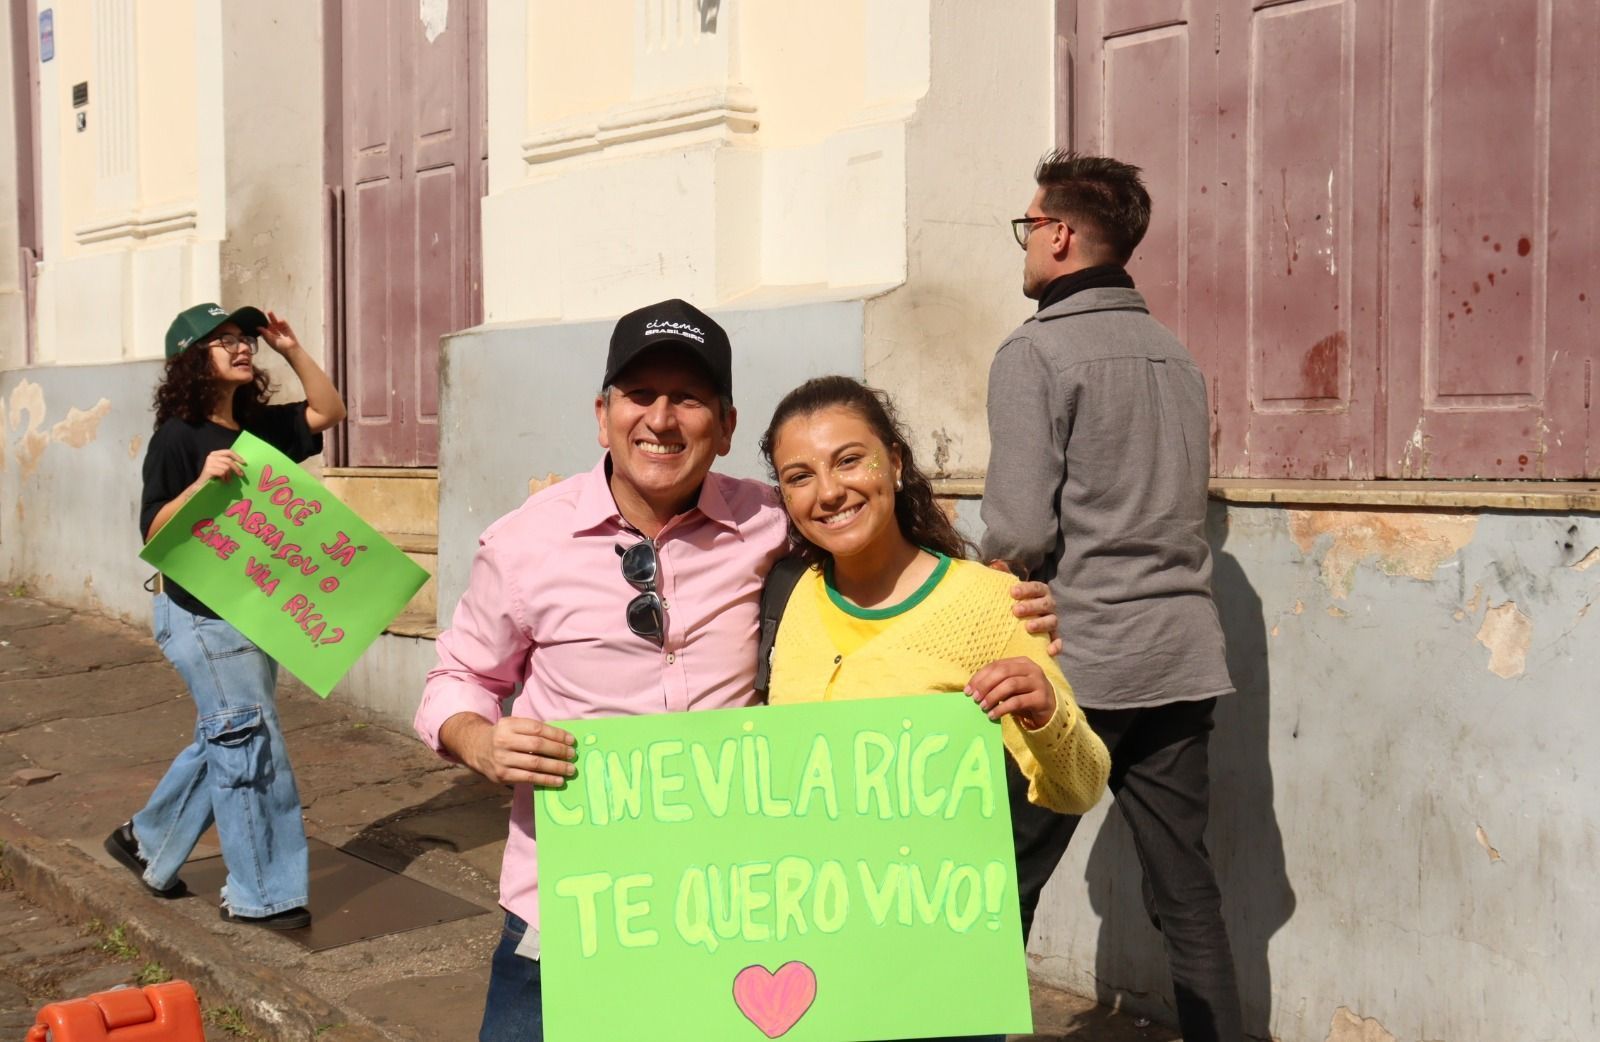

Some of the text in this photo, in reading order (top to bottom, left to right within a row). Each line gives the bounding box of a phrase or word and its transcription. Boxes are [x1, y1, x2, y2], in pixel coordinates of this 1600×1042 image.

[645, 329, 705, 344] BRASILEIRO
[646, 319, 705, 336] cinema
[225, 499, 340, 593] ABRAÇOU O
[257, 464, 368, 567] VOCÊ JÁ
[555, 871, 660, 959] TE
[674, 855, 851, 954] QUERO
